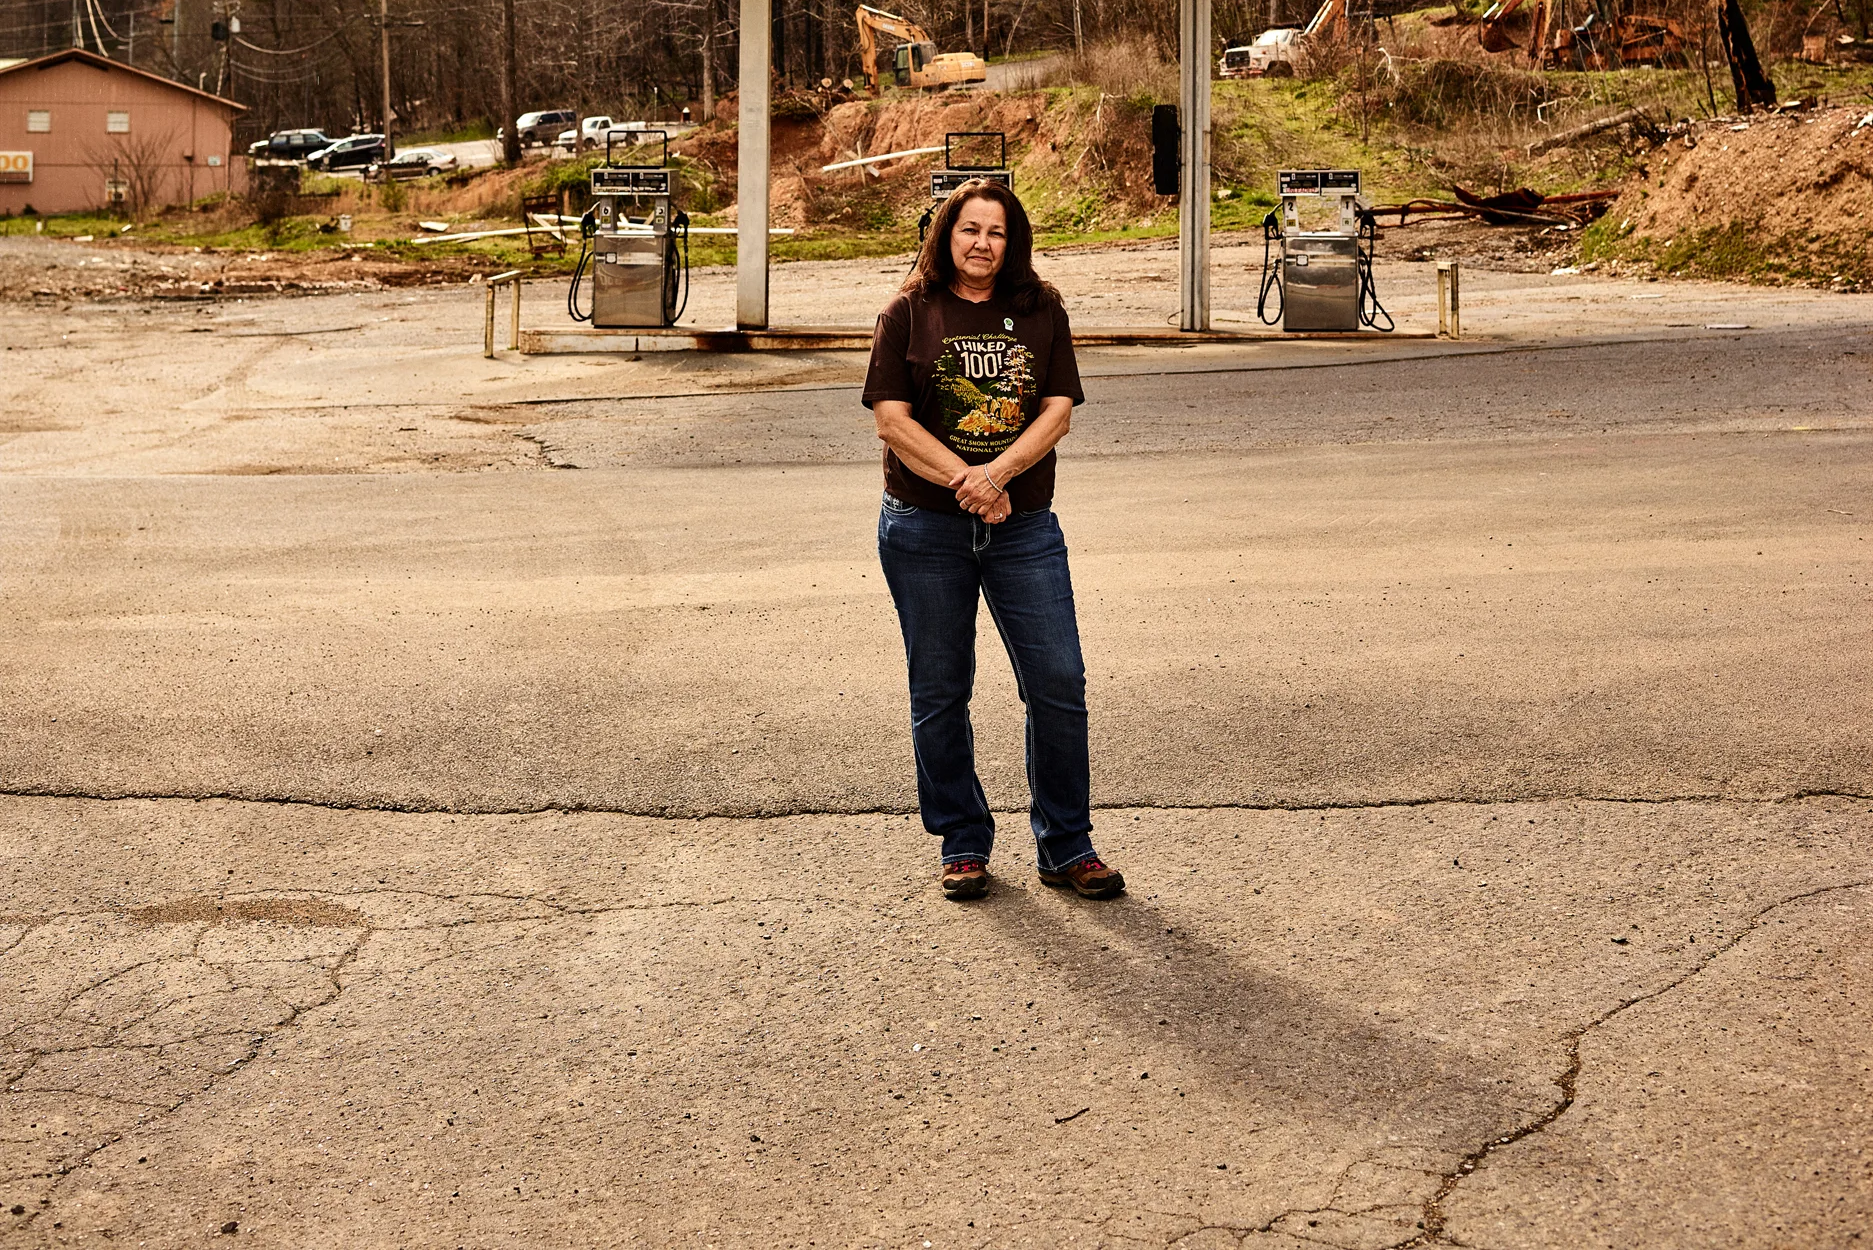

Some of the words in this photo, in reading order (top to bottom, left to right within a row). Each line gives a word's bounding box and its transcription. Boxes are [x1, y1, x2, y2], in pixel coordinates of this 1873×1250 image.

[942, 333, 981, 344] Centennial
[982, 333, 1017, 342] Challenge
[953, 342, 961, 351] I
[962, 341, 1006, 352] HIKED
[960, 351, 1003, 378] 100!
[949, 434, 968, 445] GREAT
[956, 444, 993, 453] NATIONAL
